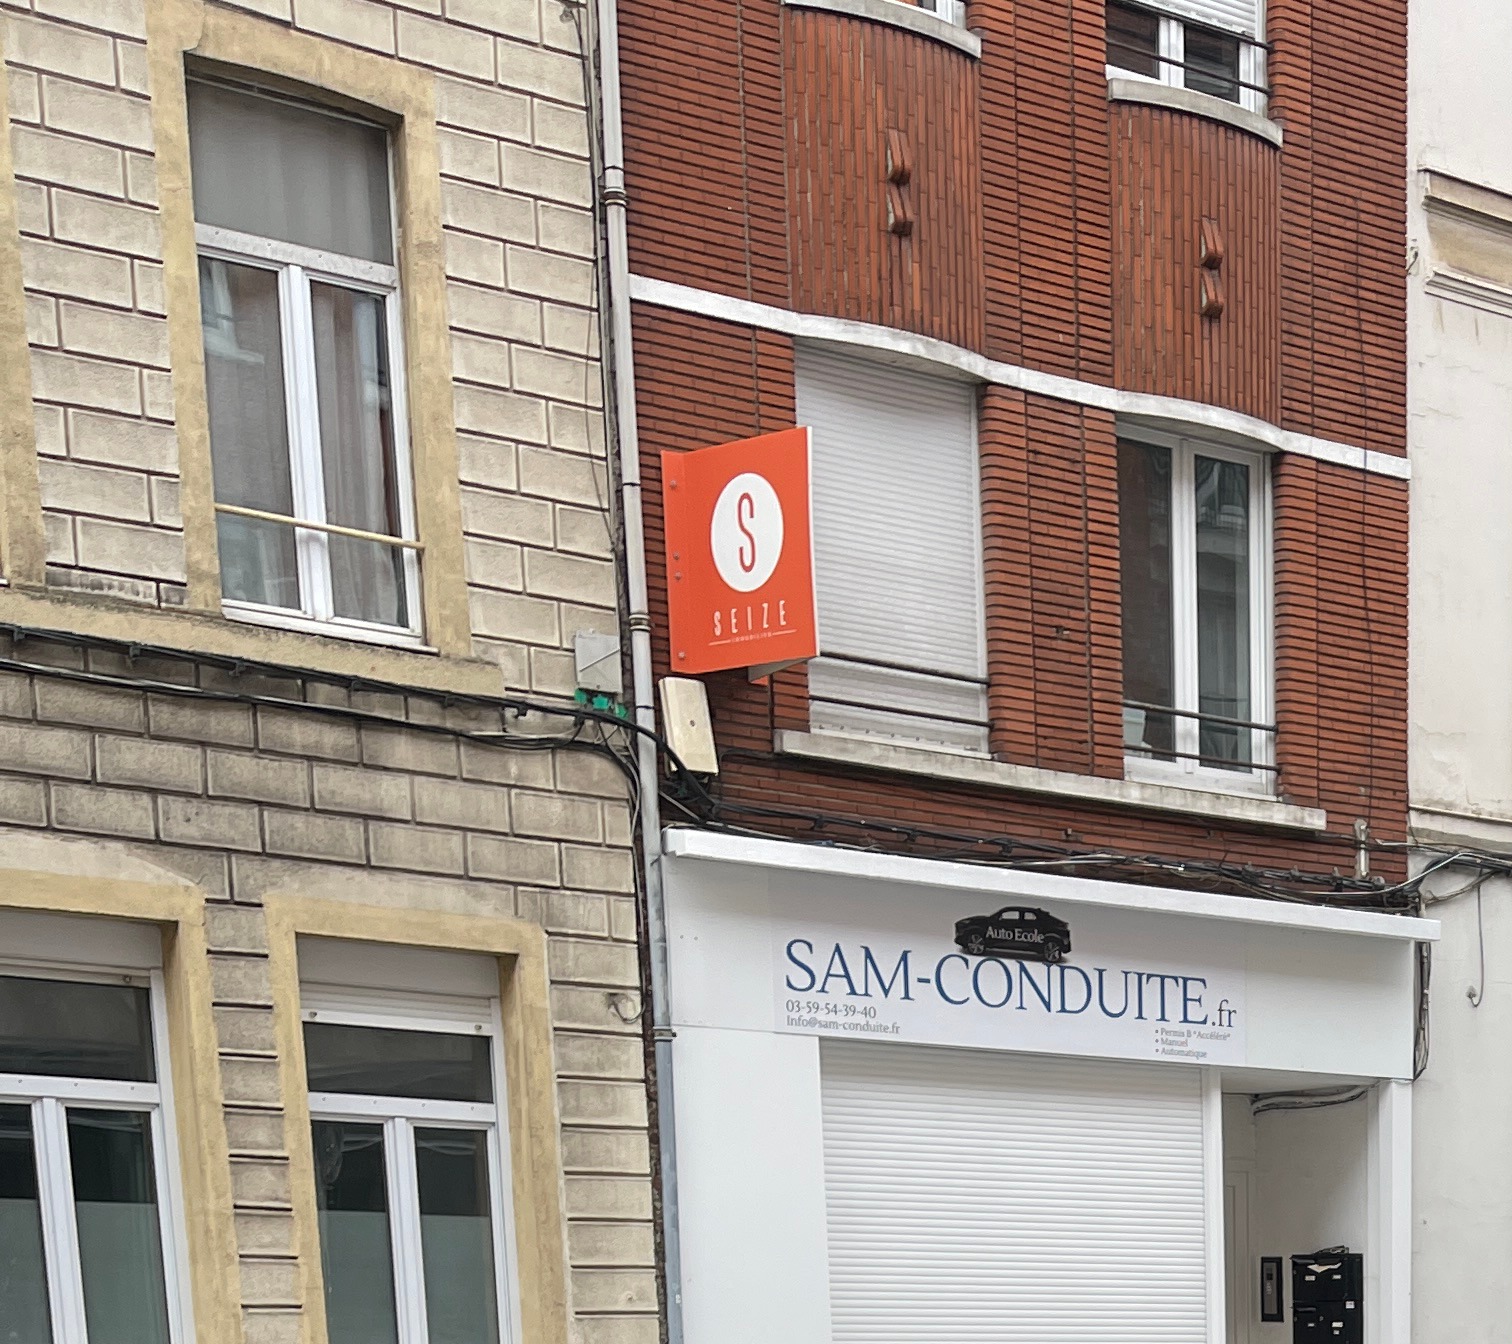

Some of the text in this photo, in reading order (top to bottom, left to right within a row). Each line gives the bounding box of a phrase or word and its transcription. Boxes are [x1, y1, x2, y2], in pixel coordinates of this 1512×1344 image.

[737, 492, 757, 573] S
[713, 599, 787, 637] SEIZE
[985, 925, 1045, 943] Auto Ecole
[785, 938, 1238, 1028] SAM-CONDUITE.fr
[785, 999, 877, 1019] 03-59-54-39-40
[1160, 1027, 1185, 1038] Permis
[1160, 1037, 1189, 1048] Manuel
[1160, 1047, 1208, 1060] Automatique
